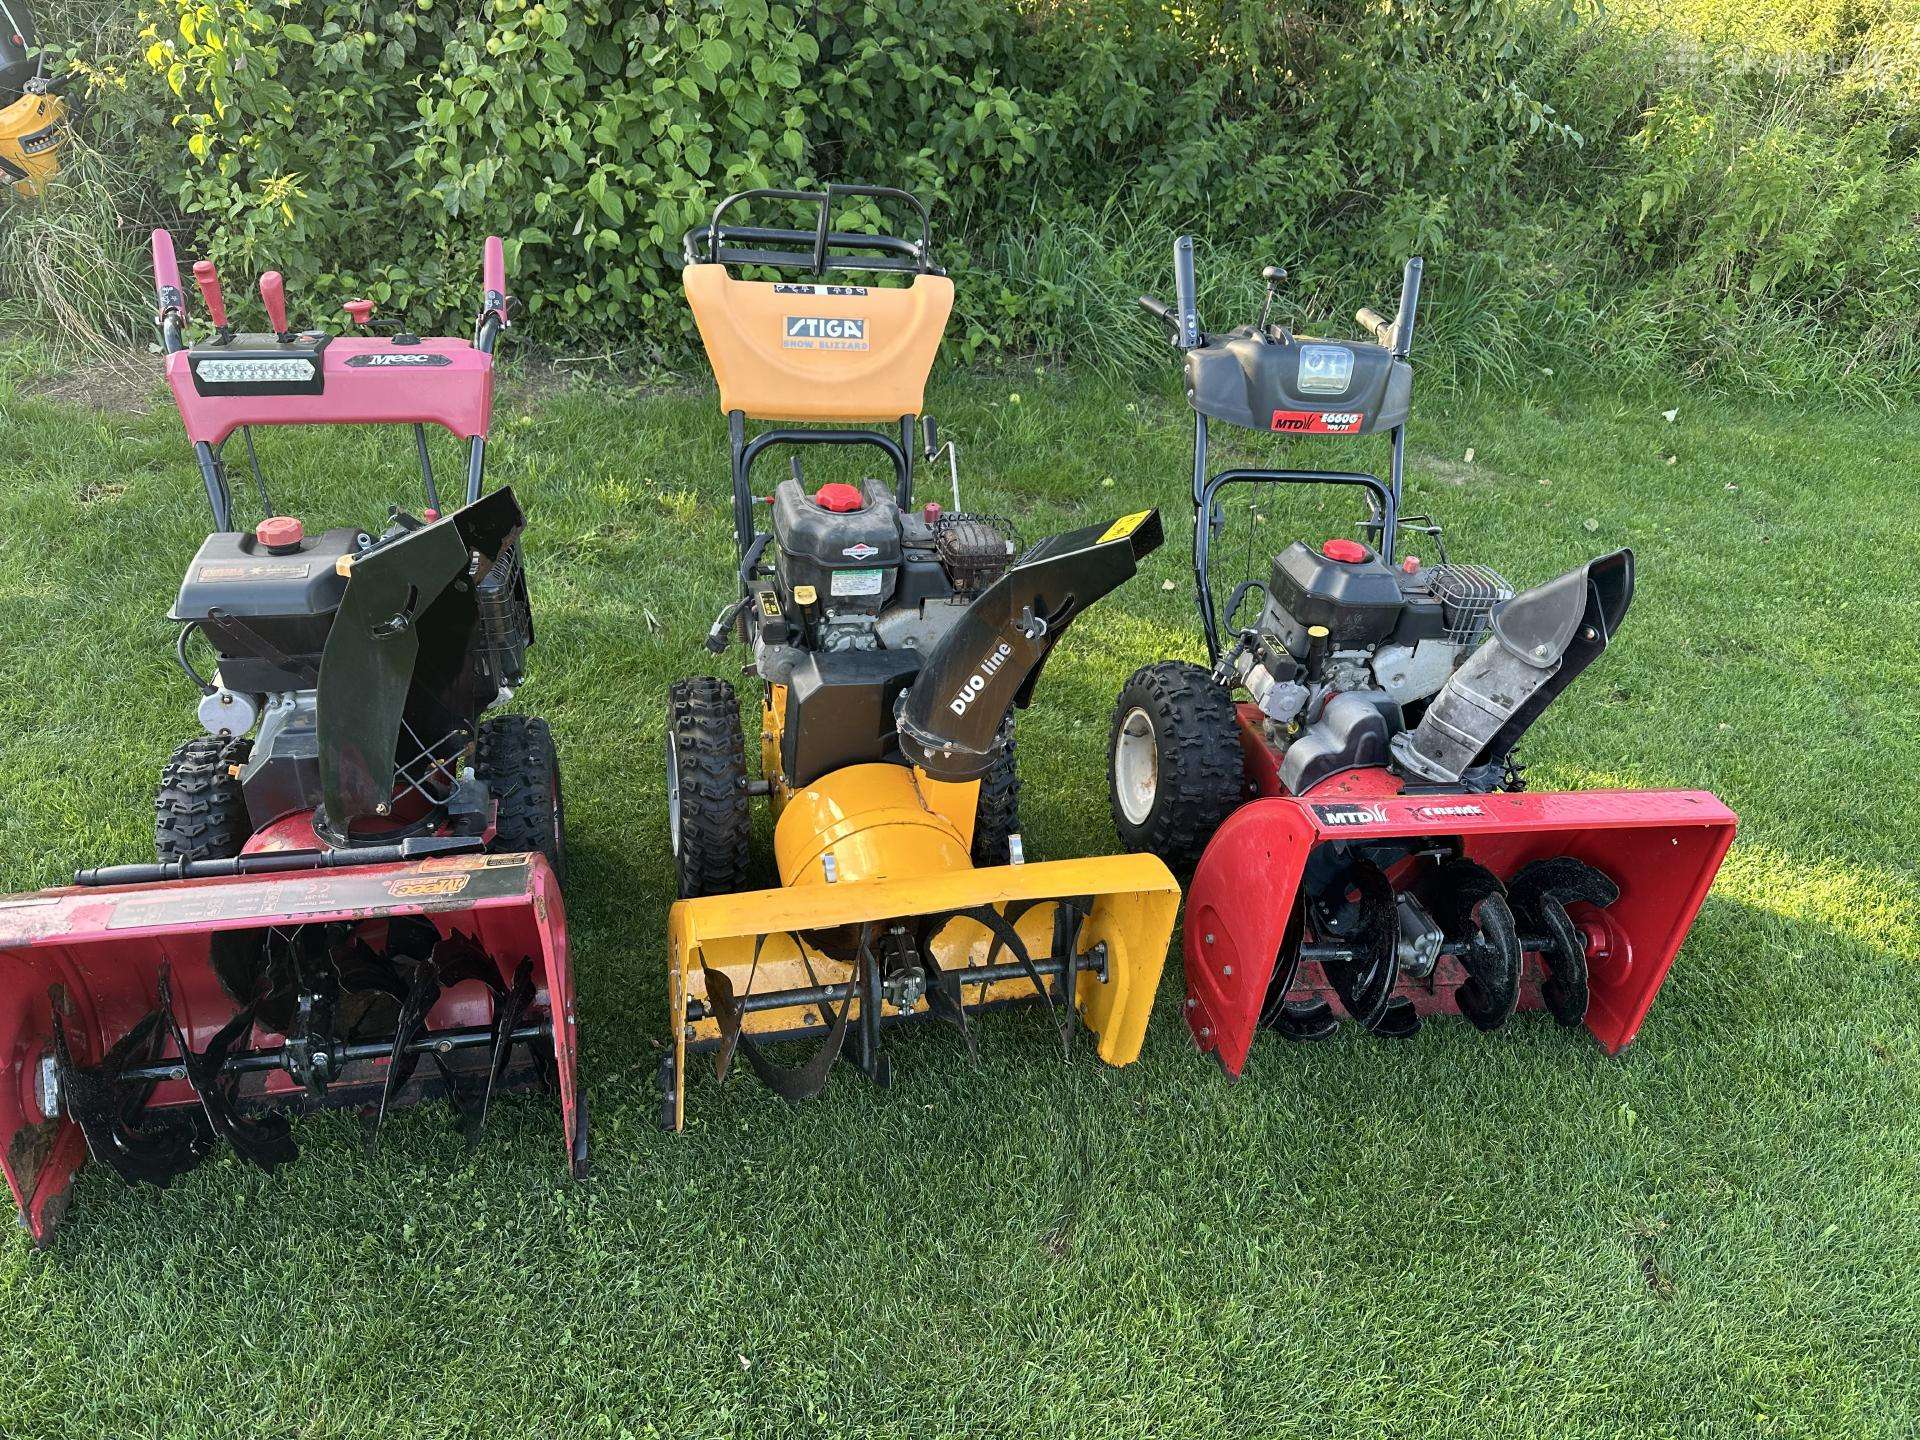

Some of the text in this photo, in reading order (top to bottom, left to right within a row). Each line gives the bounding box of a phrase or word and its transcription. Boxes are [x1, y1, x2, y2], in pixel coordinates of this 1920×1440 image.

[789, 318, 862, 338] STIGA
[368, 354, 428, 365] Meec
[1275, 419, 1304, 430] MTD
[949, 643, 1012, 716] DUO line
[1326, 811, 1375, 825] MTD
